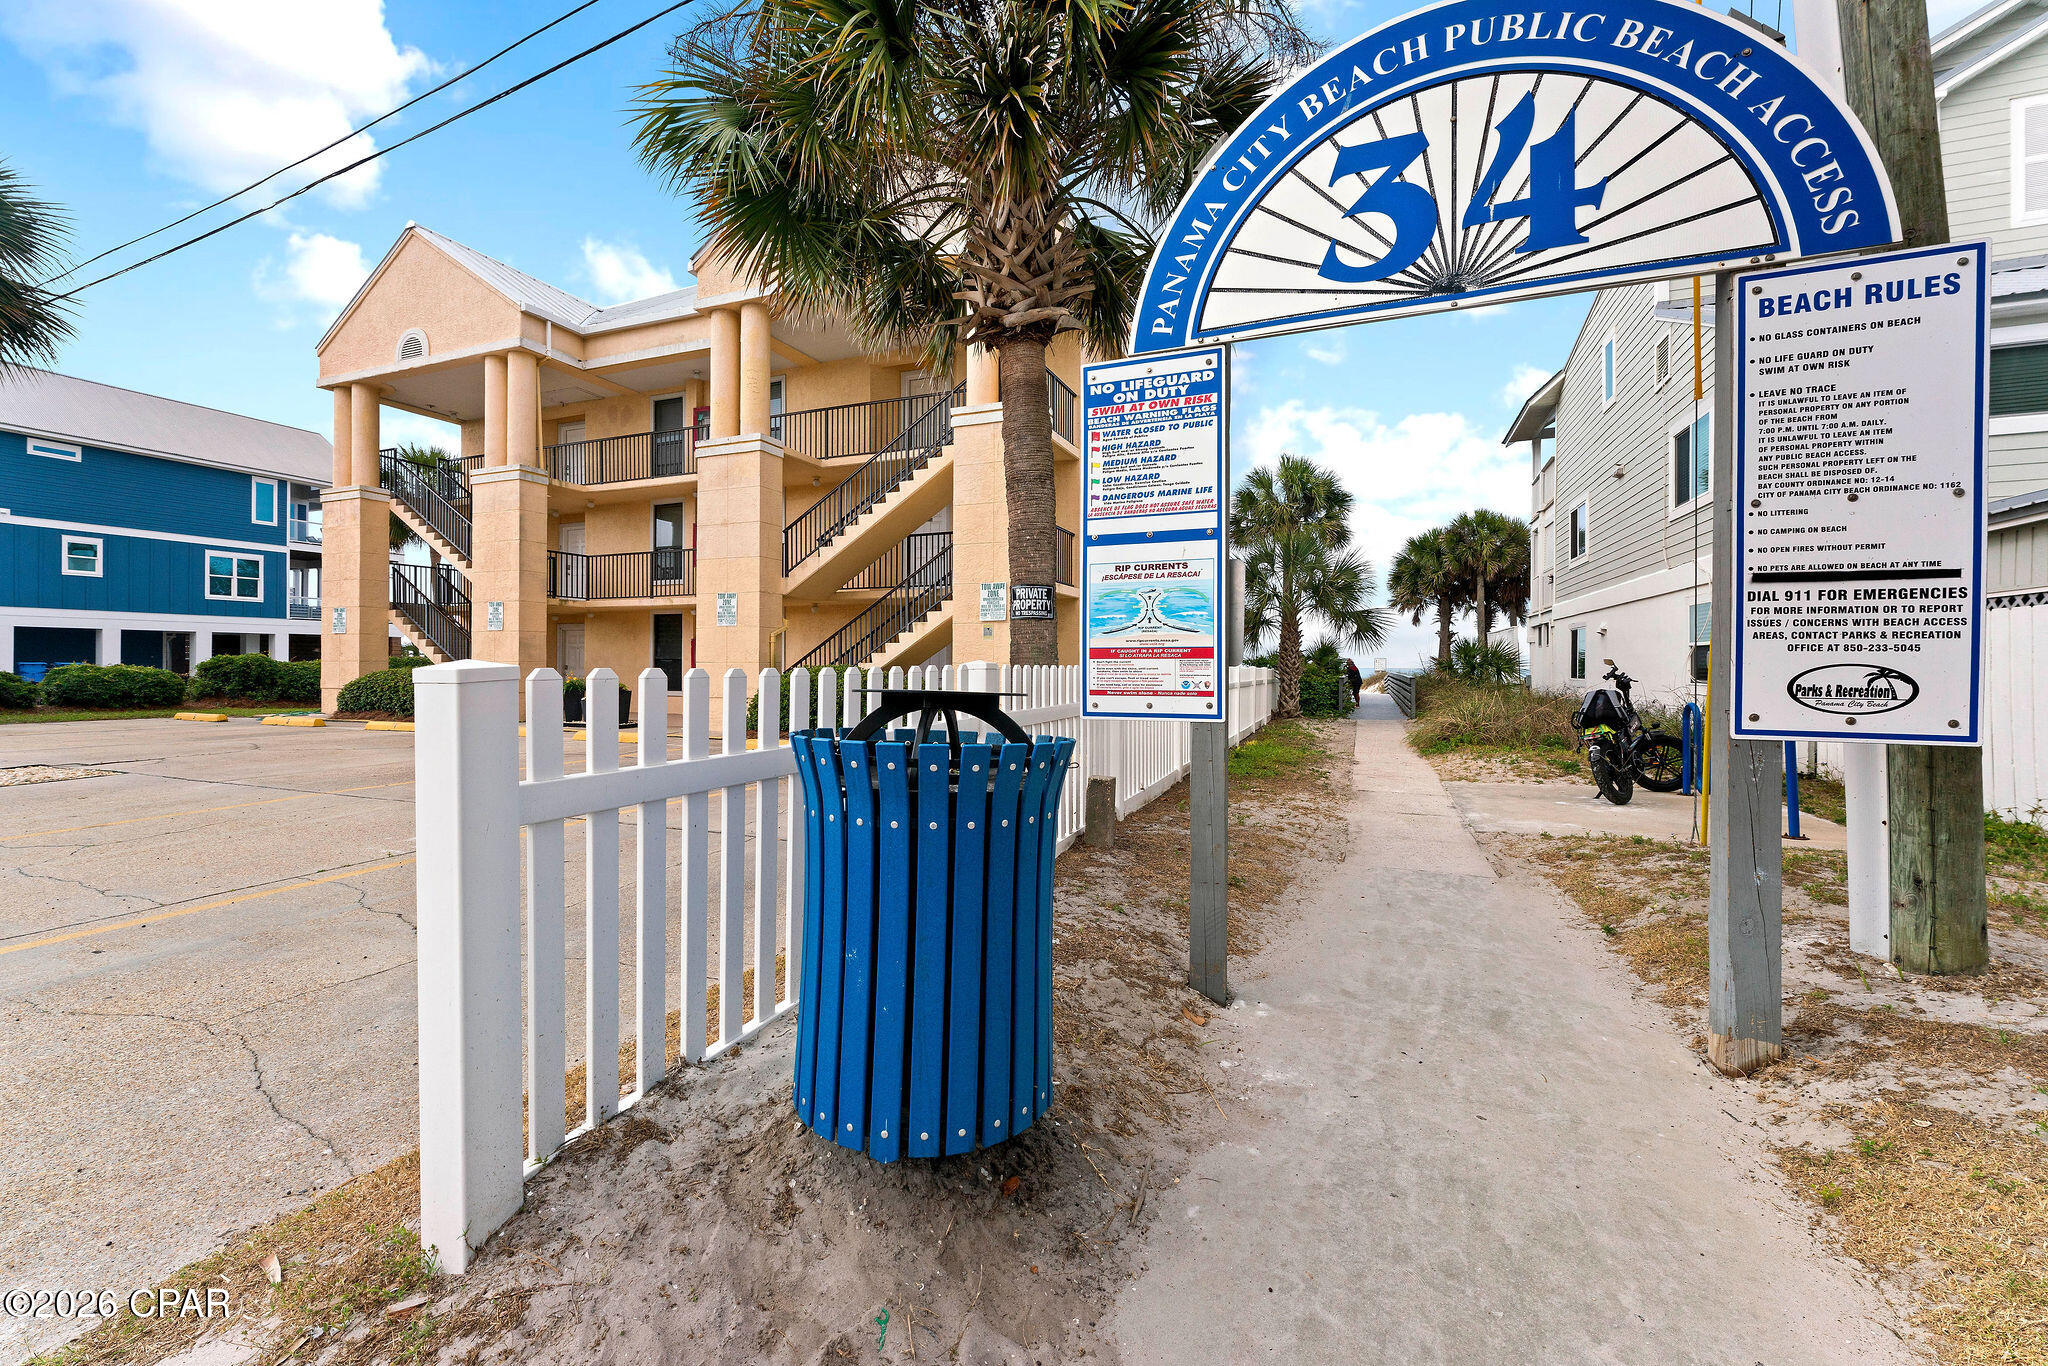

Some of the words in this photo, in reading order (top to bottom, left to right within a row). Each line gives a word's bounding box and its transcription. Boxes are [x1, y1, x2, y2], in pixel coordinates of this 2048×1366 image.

[1151, 202, 1228, 336] PANAMA
[1223, 114, 1293, 191] CITY
[1296, 33, 1430, 121] BEACH
[1444, 12, 1606, 52] PUBLIC
[1610, 19, 1762, 100] BEACH
[1748, 95, 1860, 235] ACCESS
[1318, 90, 1608, 283] 34
[1759, 288, 1852, 317] BEACH
[1865, 274, 1960, 304] RULES
[1775, 330, 1803, 340] GLASS
[1807, 323, 1866, 336] CONTAINERS
[1870, 321, 1883, 329] ON
[1888, 317, 1921, 327] BEACH
[1775, 354, 1794, 362] LIFE
[1797, 351, 1829, 360] GUARD
[1849, 346, 1874, 355] DUTY
[1759, 366, 1785, 375] SWIM
[1803, 362, 1824, 371] OWN
[1828, 360, 1850, 368] RISK
[1090, 384, 1115, 395] NO
[1121, 371, 1214, 391] LIFEGUARD
[1113, 391, 1138, 403] ON
[1145, 384, 1189, 400] DUTY
[1759, 389, 1786, 398] LEAVE
[1790, 387, 1802, 395] NO
[1806, 384, 1836, 393] TRACE
[1092, 405, 1124, 416] SWIM
[1129, 403, 1145, 412] AT
[1149, 398, 1179, 409] OWN
[1184, 394, 1213, 405] RISK
[1759, 408, 1797, 416] PERSONAL
[1800, 404, 1840, 412] PROPERTY
[1874, 398, 1909, 406] PORTION
[1778, 397, 1818, 405] UNLAWFUL
[1088, 416, 1120, 426] BEACH
[1124, 409, 1178, 421] WARNING
[1182, 405, 1217, 414] FLAGS
[1102, 429, 1131, 437] WATER
[1134, 425, 1165, 434] CLOSED
[1183, 420, 1213, 429] PUBLIC
[1126, 440, 1161, 449] HAZARD
[1103, 458, 1137, 467] MEDIUM
[1141, 454, 1177, 463] HAZARD
[1125, 473, 1160, 482] HAZARD
[1807, 478, 1851, 486] ORDINANCE
[1102, 491, 1154, 501] DANGEROUS
[1158, 488, 1192, 497] MARINE
[1844, 487, 1870, 495] BEACH
[1873, 484, 1920, 492] ORDINANCE
[1940, 482, 1961, 490] 1162
[1115, 563, 1131, 572] RIP
[1134, 562, 1188, 571] CURRENTS
[1016, 588, 1047, 599] PRIVATE
[1748, 591, 1779, 602] DIAL
[1785, 590, 1810, 601] 911
[1818, 590, 1847, 600] FOR
[1854, 587, 1968, 600] EMERGENCIES
[1013, 599, 1050, 610] PROPERTY
[1807, 606, 1879, 614] INFORMATION
[1883, 605, 1897, 613] OR
[1901, 605, 1915, 613] TO
[1919, 604, 1963, 613] REPORT
[1747, 619, 1782, 627] ISSUES
[1785, 619, 1789, 628] /
[1793, 619, 1848, 627] CONCERNS
[1883, 618, 1919, 626] BEACH
[1923, 618, 1967, 626] ACCESS
[1752, 632, 1788, 640] AREAS,
[1842, 631, 1876, 639] PARKS
[1880, 631, 1888, 639] &
[1892, 631, 1961, 639] RECREATION
[1843, 644, 1921, 652] 850-233-5045
[1795, 684, 1823, 697] Parks
[1825, 684, 1832, 697] &
[1835, 685, 1890, 698] Recreation
[1848, 700, 1864, 708] City
